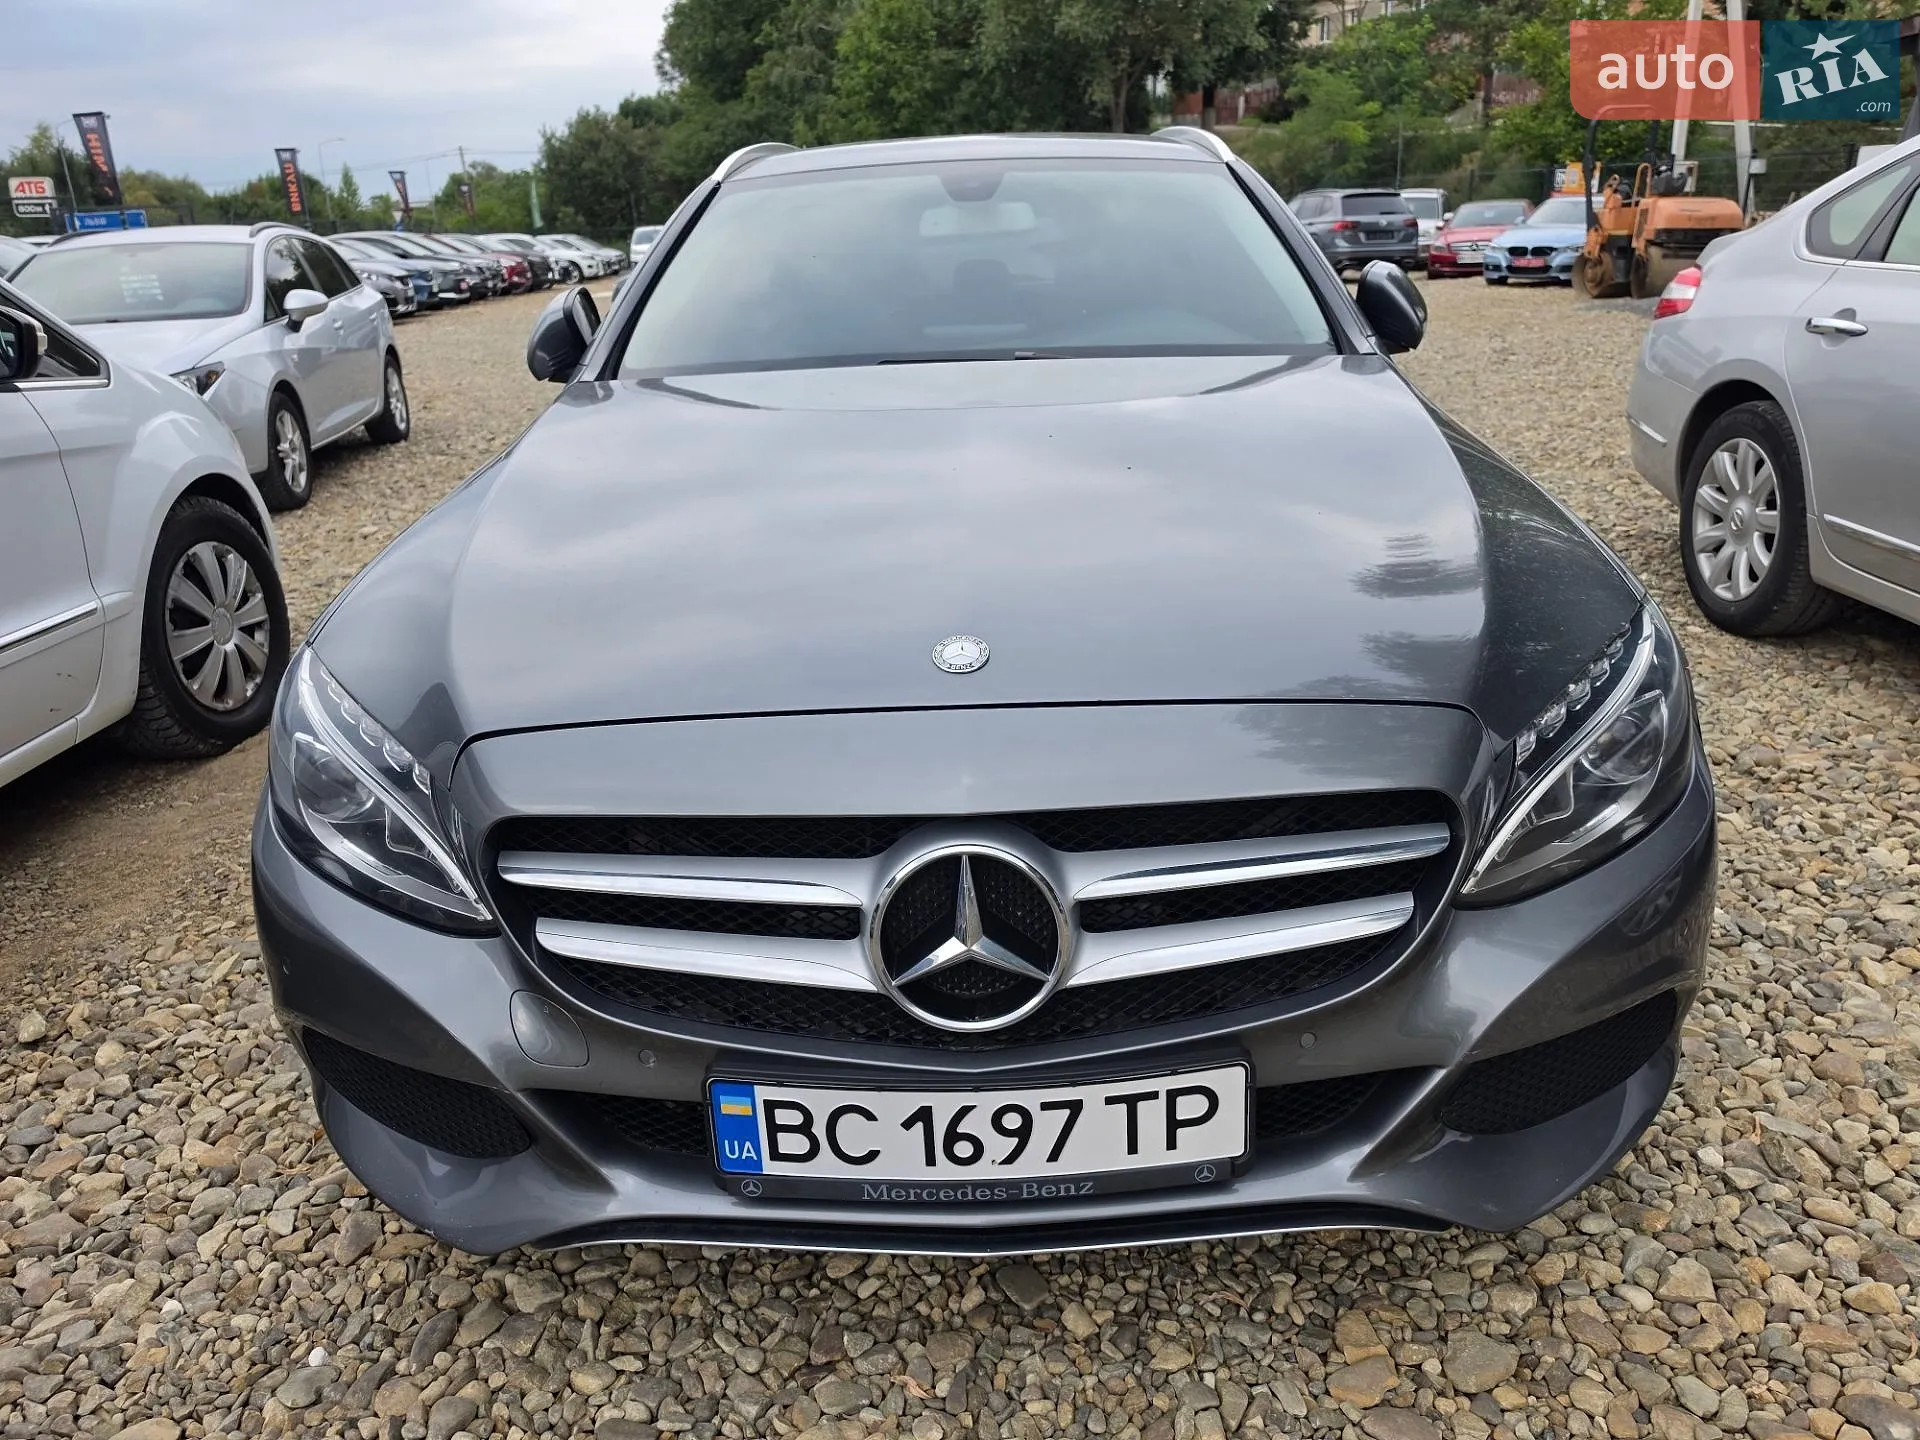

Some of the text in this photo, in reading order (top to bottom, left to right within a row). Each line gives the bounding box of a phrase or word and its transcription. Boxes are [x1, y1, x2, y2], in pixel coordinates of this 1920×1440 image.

[762, 1084, 1220, 1167] BC 1697 TP
[724, 1139, 758, 1160] UA
[861, 1182, 1094, 1201] Mercedes-Benz
